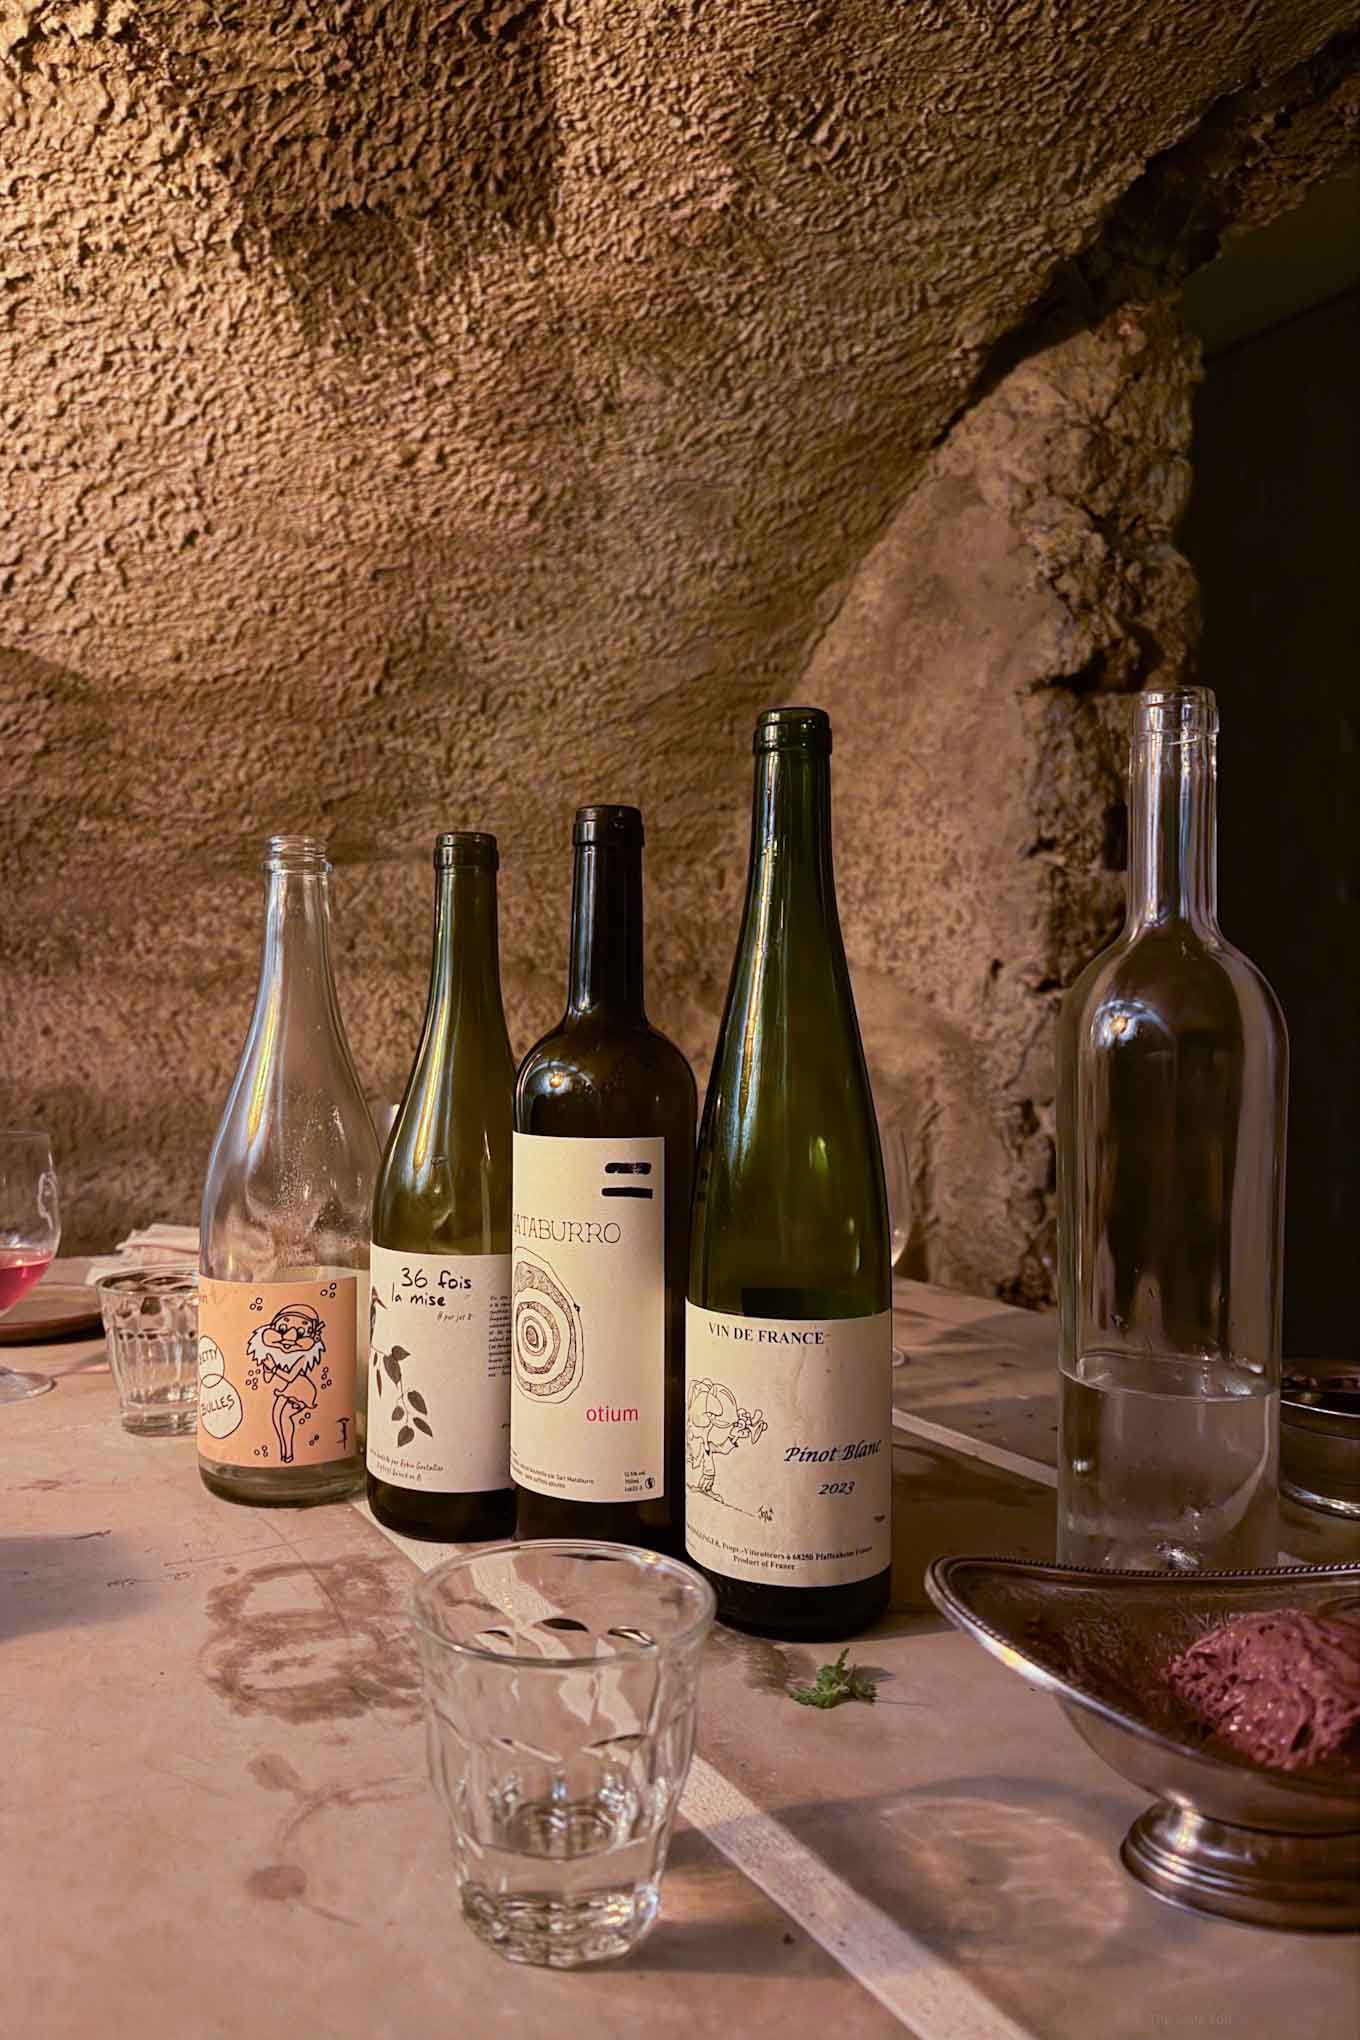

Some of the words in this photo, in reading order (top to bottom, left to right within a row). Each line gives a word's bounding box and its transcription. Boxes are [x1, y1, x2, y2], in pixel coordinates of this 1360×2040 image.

[401, 1266, 429, 1289] 36
[437, 1269, 473, 1290] fois
[391, 1280, 403, 1303] la
[409, 1291, 447, 1307] mise
[707, 1321, 730, 1338] VIN
[733, 1327, 754, 1342] DE
[757, 1329, 826, 1345] FRANCE
[201, 1393, 236, 1417] BULLES
[585, 1405, 639, 1423] otium
[783, 1446, 838, 1463] Pinot
[817, 1480, 856, 1496] 2023
